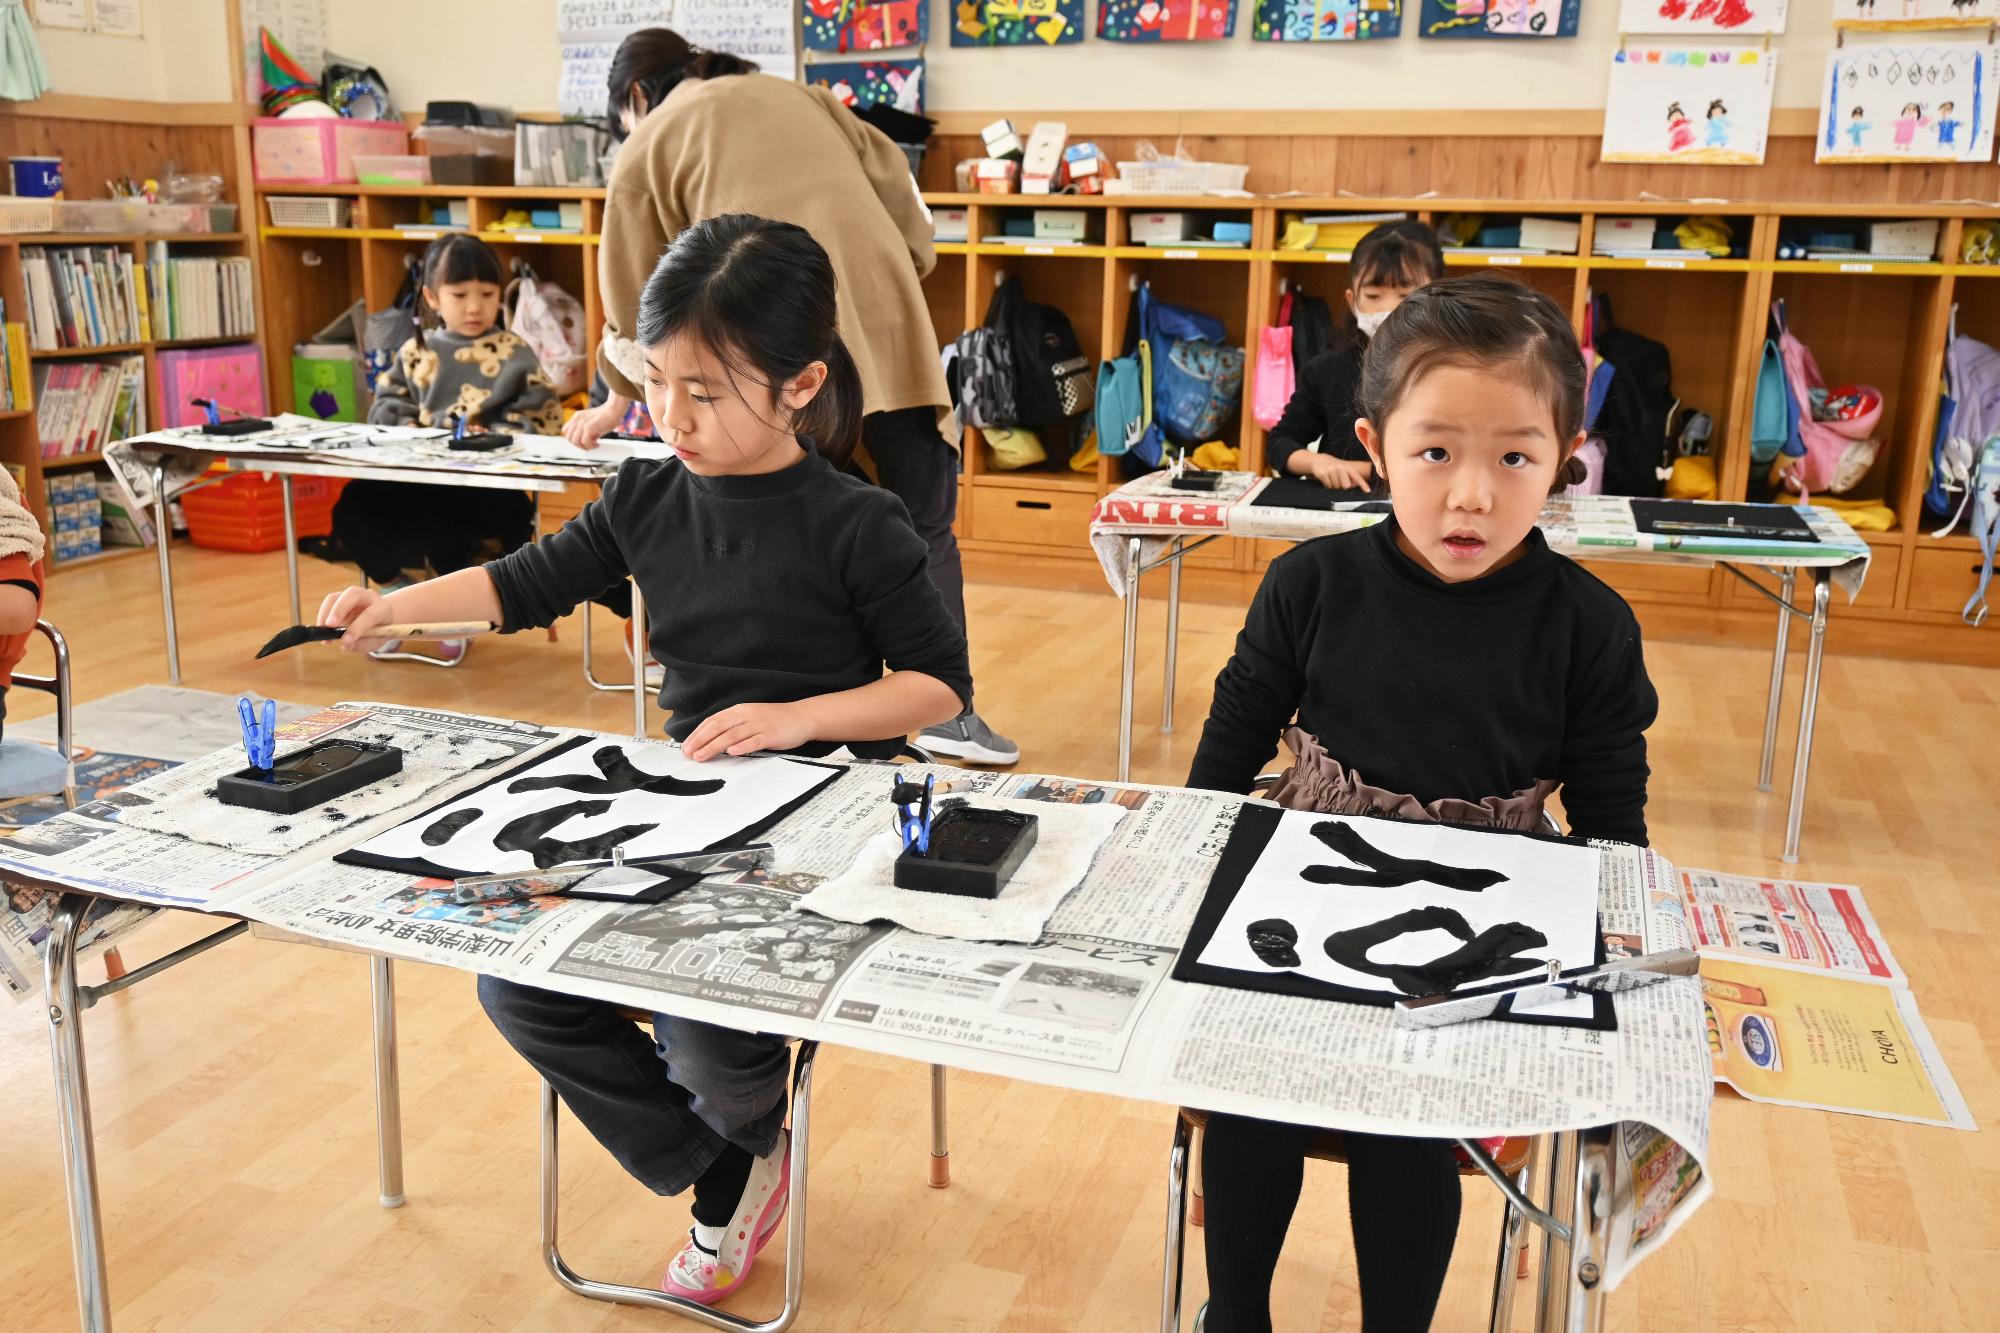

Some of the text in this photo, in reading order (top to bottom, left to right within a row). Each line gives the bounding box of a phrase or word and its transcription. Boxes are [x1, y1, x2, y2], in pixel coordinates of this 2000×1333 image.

[377, 923, 513, 958] 山梨学院男女
[1872, 1030, 1898, 1065] CHOYA
